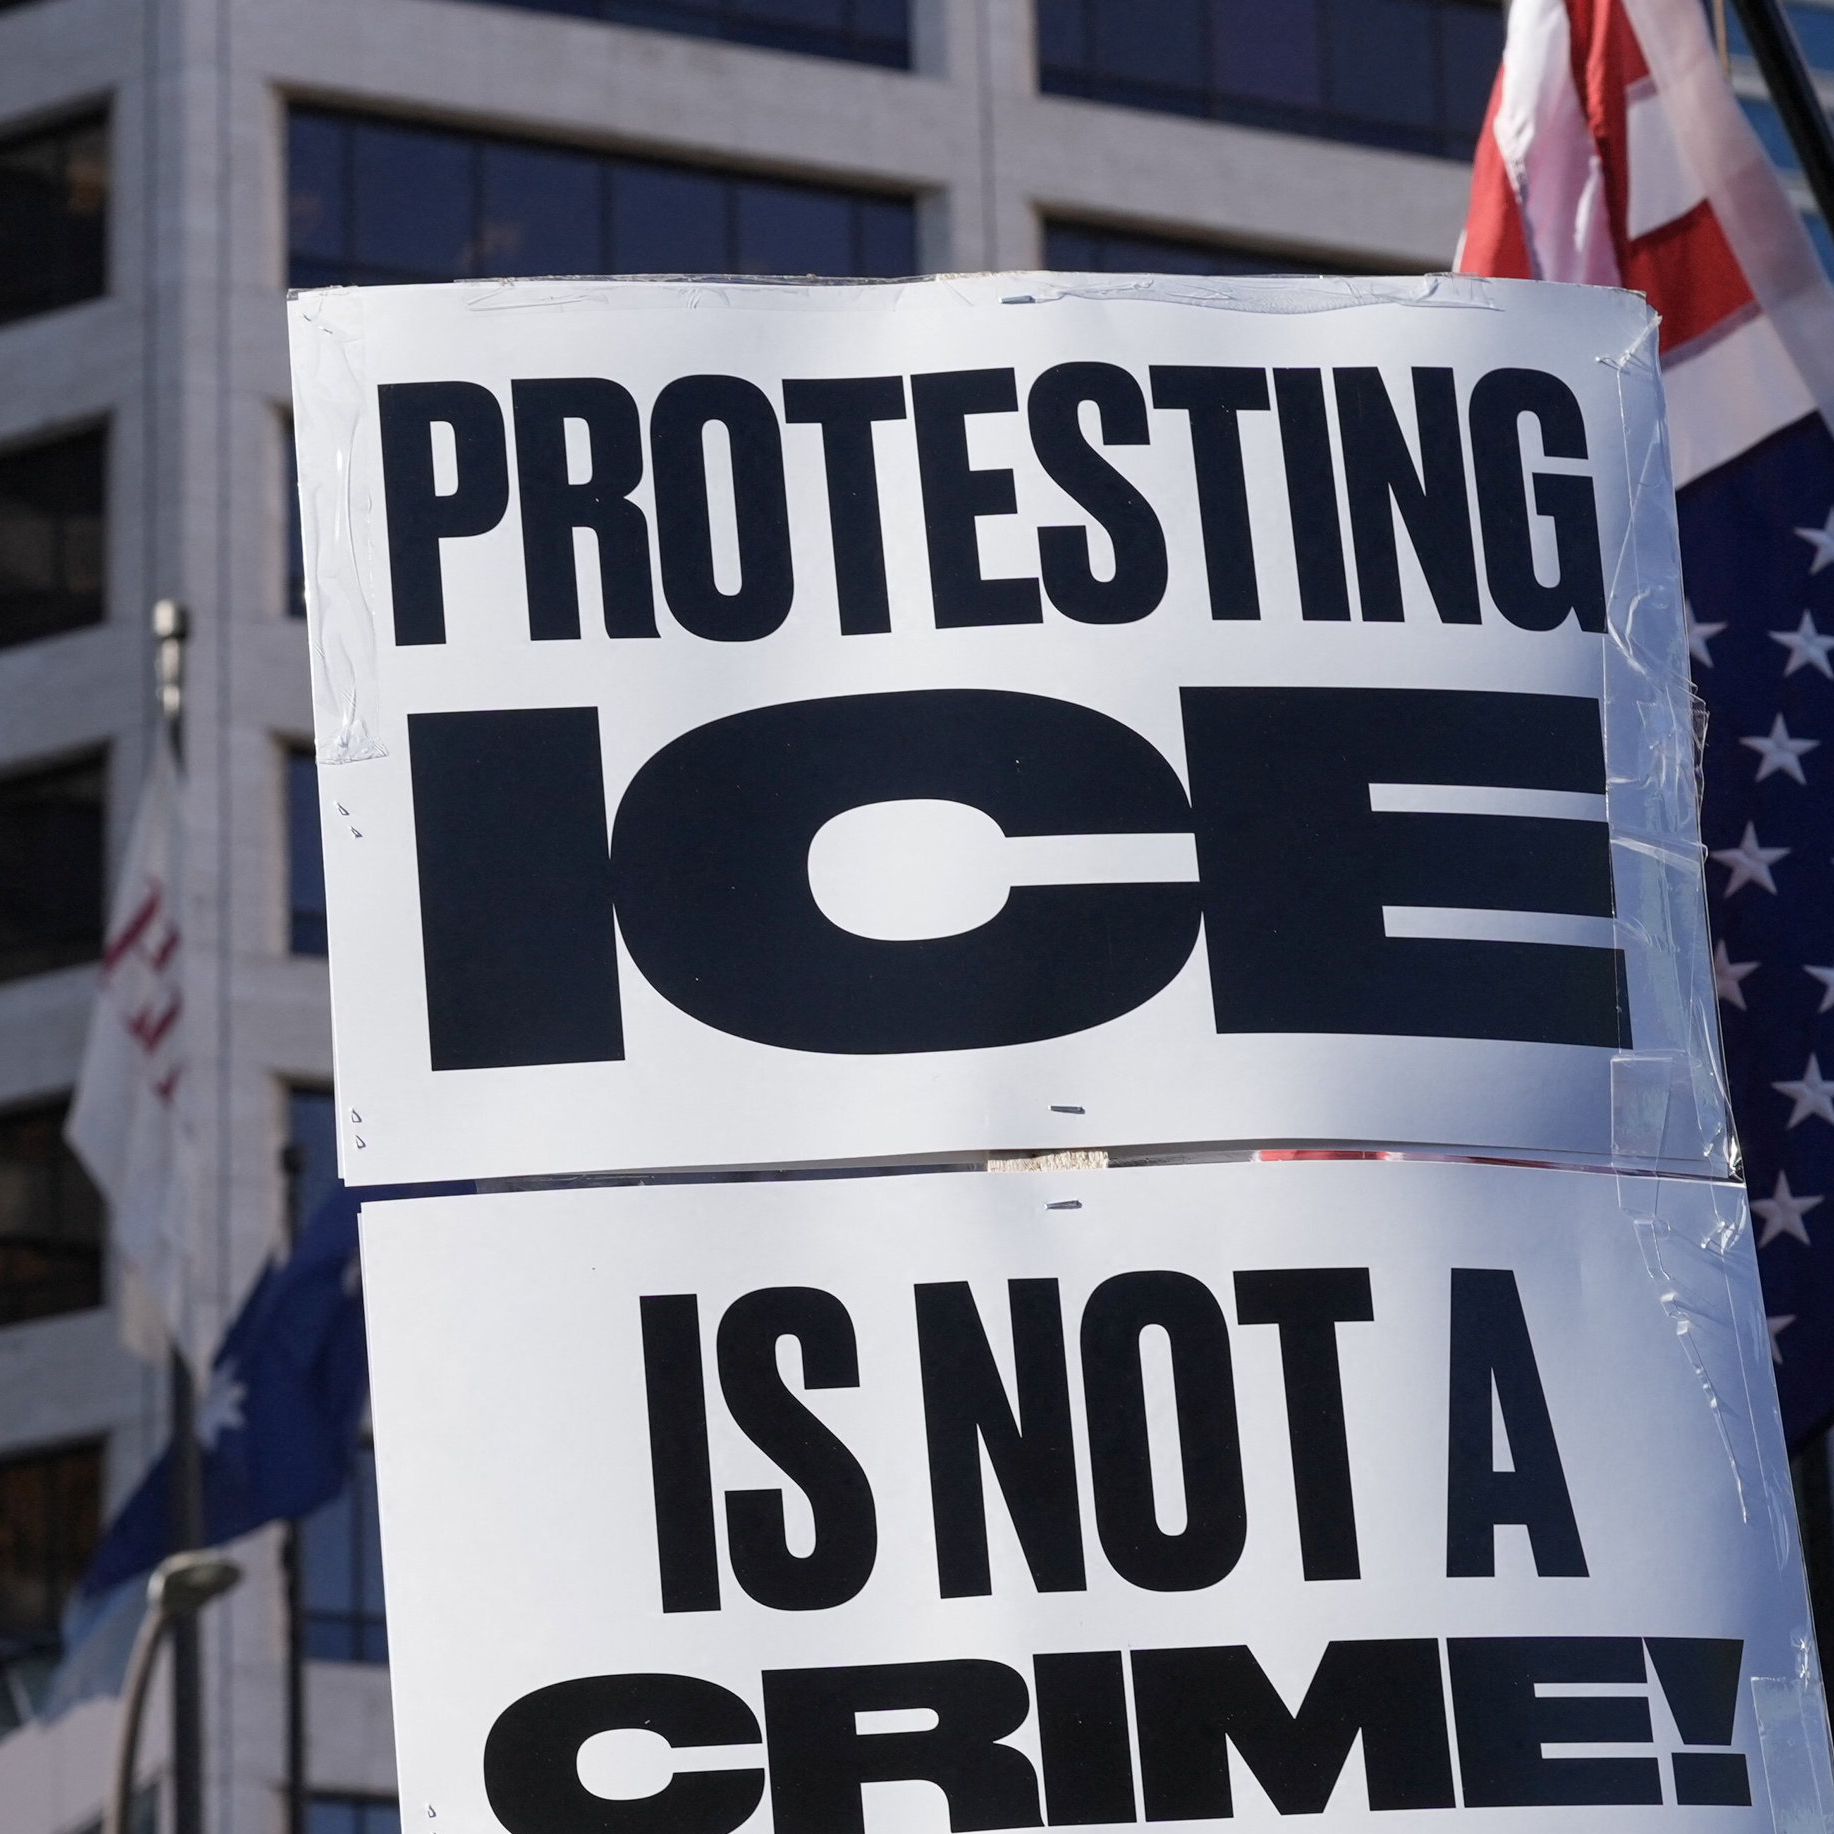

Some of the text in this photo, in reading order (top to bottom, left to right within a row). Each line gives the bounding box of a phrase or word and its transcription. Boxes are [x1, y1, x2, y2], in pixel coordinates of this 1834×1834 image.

[377, 361, 1608, 646] PROTESTING
[407, 686, 1633, 1072] ICE
[639, 1267, 1589, 1612] IS NOT A
